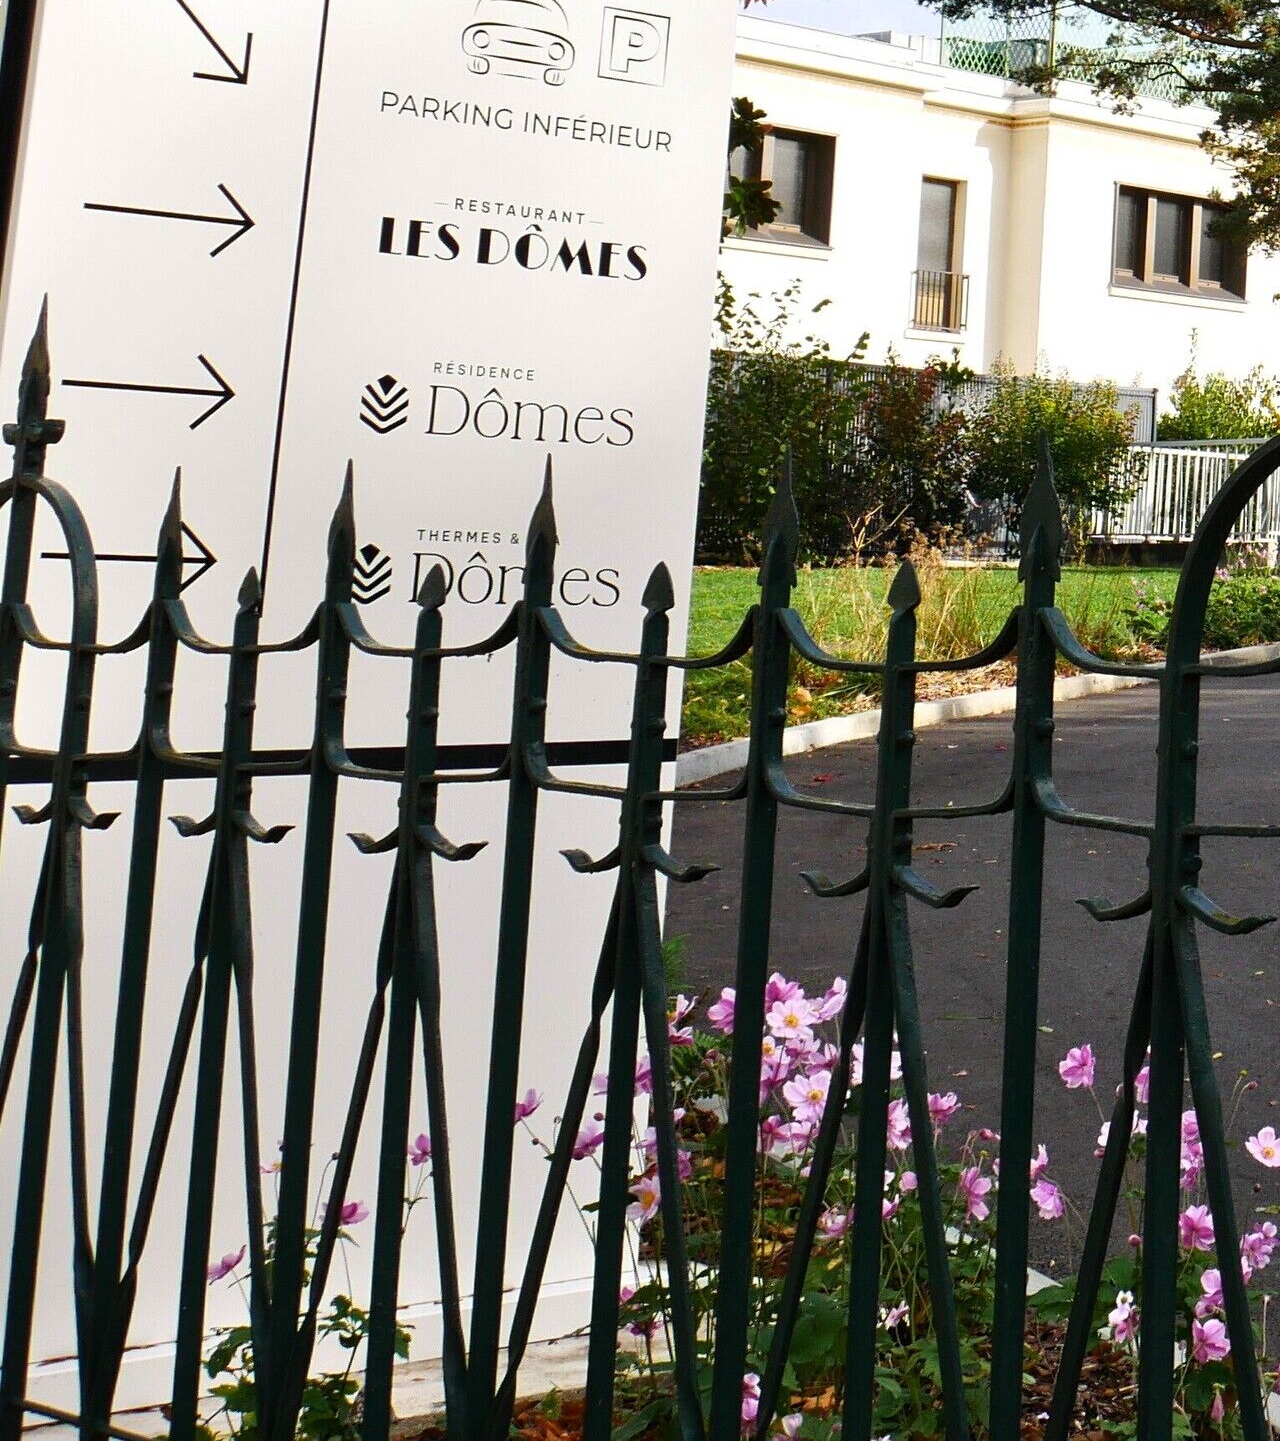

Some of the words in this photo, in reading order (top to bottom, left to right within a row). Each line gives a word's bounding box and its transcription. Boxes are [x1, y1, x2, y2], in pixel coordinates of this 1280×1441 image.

[609, 15, 661, 73] P
[380, 91, 513, 130] PARKING
[523, 112, 672, 152] INFÉRIEUR
[454, 197, 587, 224] RESTAURANT
[378, 216, 461, 261] LES
[475, 223, 648, 281] DÔMES
[433, 361, 535, 381] RÉSIDENCE
[424, 385, 634, 446] Dômes
[417, 529, 501, 544] THERMES
[510, 533, 519, 544] &
